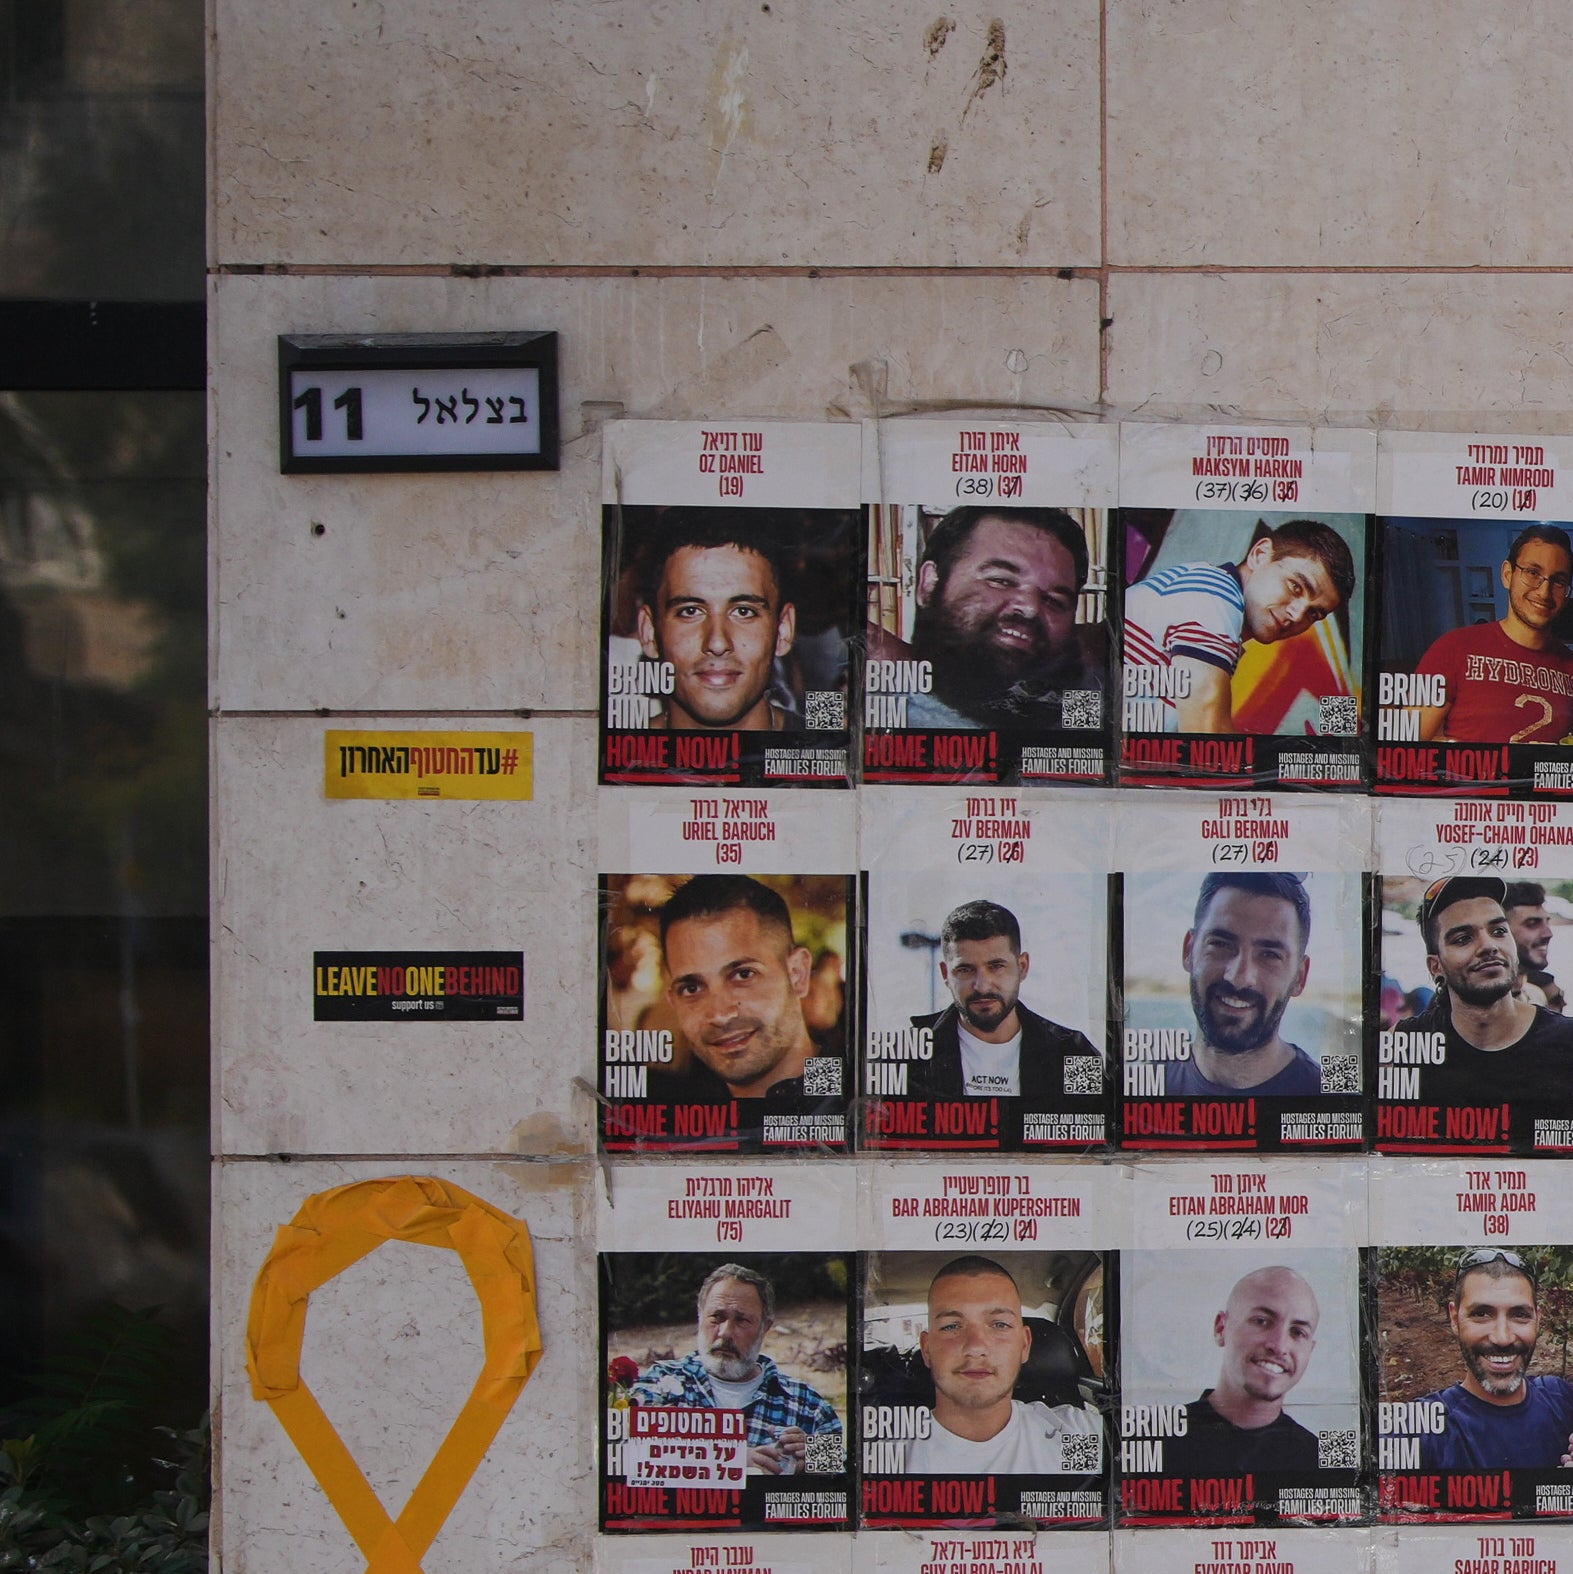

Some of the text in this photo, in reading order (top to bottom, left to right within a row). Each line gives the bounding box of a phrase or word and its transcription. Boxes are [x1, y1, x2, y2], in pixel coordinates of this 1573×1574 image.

[294, 387, 528, 441] בצלאל 11
[701, 431, 764, 452] עוז דניאל
[699, 453, 764, 475] OZ DANIEL
[951, 453, 1029, 474] EITAN HORN
[1191, 456, 1304, 479] MAKSYM HARKIN
[719, 476, 744, 496] (19)
[1456, 465, 1555, 488] TAMIR NIMRODI
[1378, 672, 1446, 706] BRING
[1377, 708, 1420, 741] HIM
[1508, 693, 1553, 745] 2
[1376, 747, 1439, 780] HOME
[1534, 762, 1569, 773] HOSTAGES
[682, 821, 777, 841] URIEL BARUCH
[952, 819, 1032, 840] ZIV BERMAN
[1201, 819, 1290, 839] GALI BERMAN
[1436, 824, 1527, 845] YOSEF-CHAIM
[391, 999, 423, 1011] support
[424, 1001, 434, 1010] us
[667, 1199, 792, 1219] ELIYAHU MARGALIT
[892, 1197, 1081, 1217] BAR ABRAHAM KUPERSHTEIN
[1169, 1195, 1309, 1216] EITAN ABRAHAM MOR
[1456, 1192, 1537, 1213] TAMIR ADAR
[716, 1220, 744, 1241] (75)
[1484, 1214, 1510, 1235] (38)
[636, 1411, 745, 1435] דם החטופים
[649, 1443, 736, 1460] על הידיים
[716, 1464, 743, 1482] של
